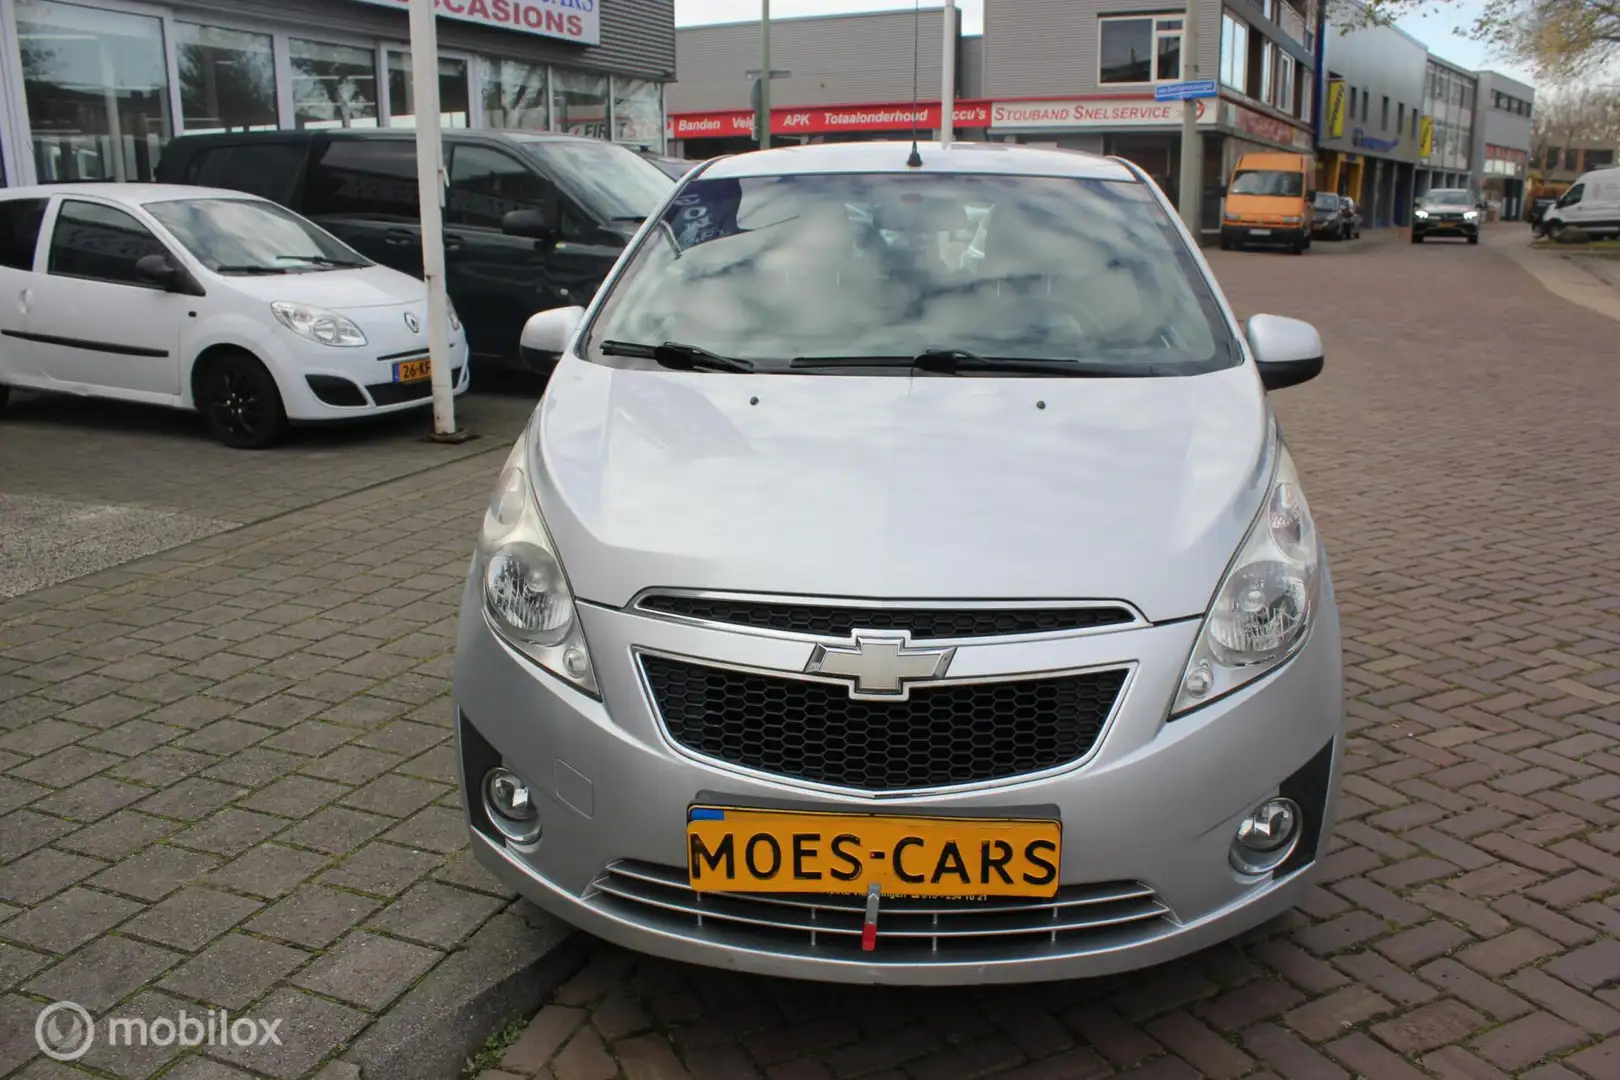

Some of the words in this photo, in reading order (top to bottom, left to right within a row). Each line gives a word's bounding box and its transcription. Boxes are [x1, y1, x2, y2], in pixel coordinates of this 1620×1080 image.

[396, 0, 583, 36] CASIONS
[678, 119, 721, 131] Banden
[783, 114, 810, 126] APK
[824, 109, 928, 125] Totaalonderhoud
[952, 107, 986, 121] ccu's
[994, 107, 1069, 122] STOUBAND
[690, 832, 1057, 886] MOES-CARS
